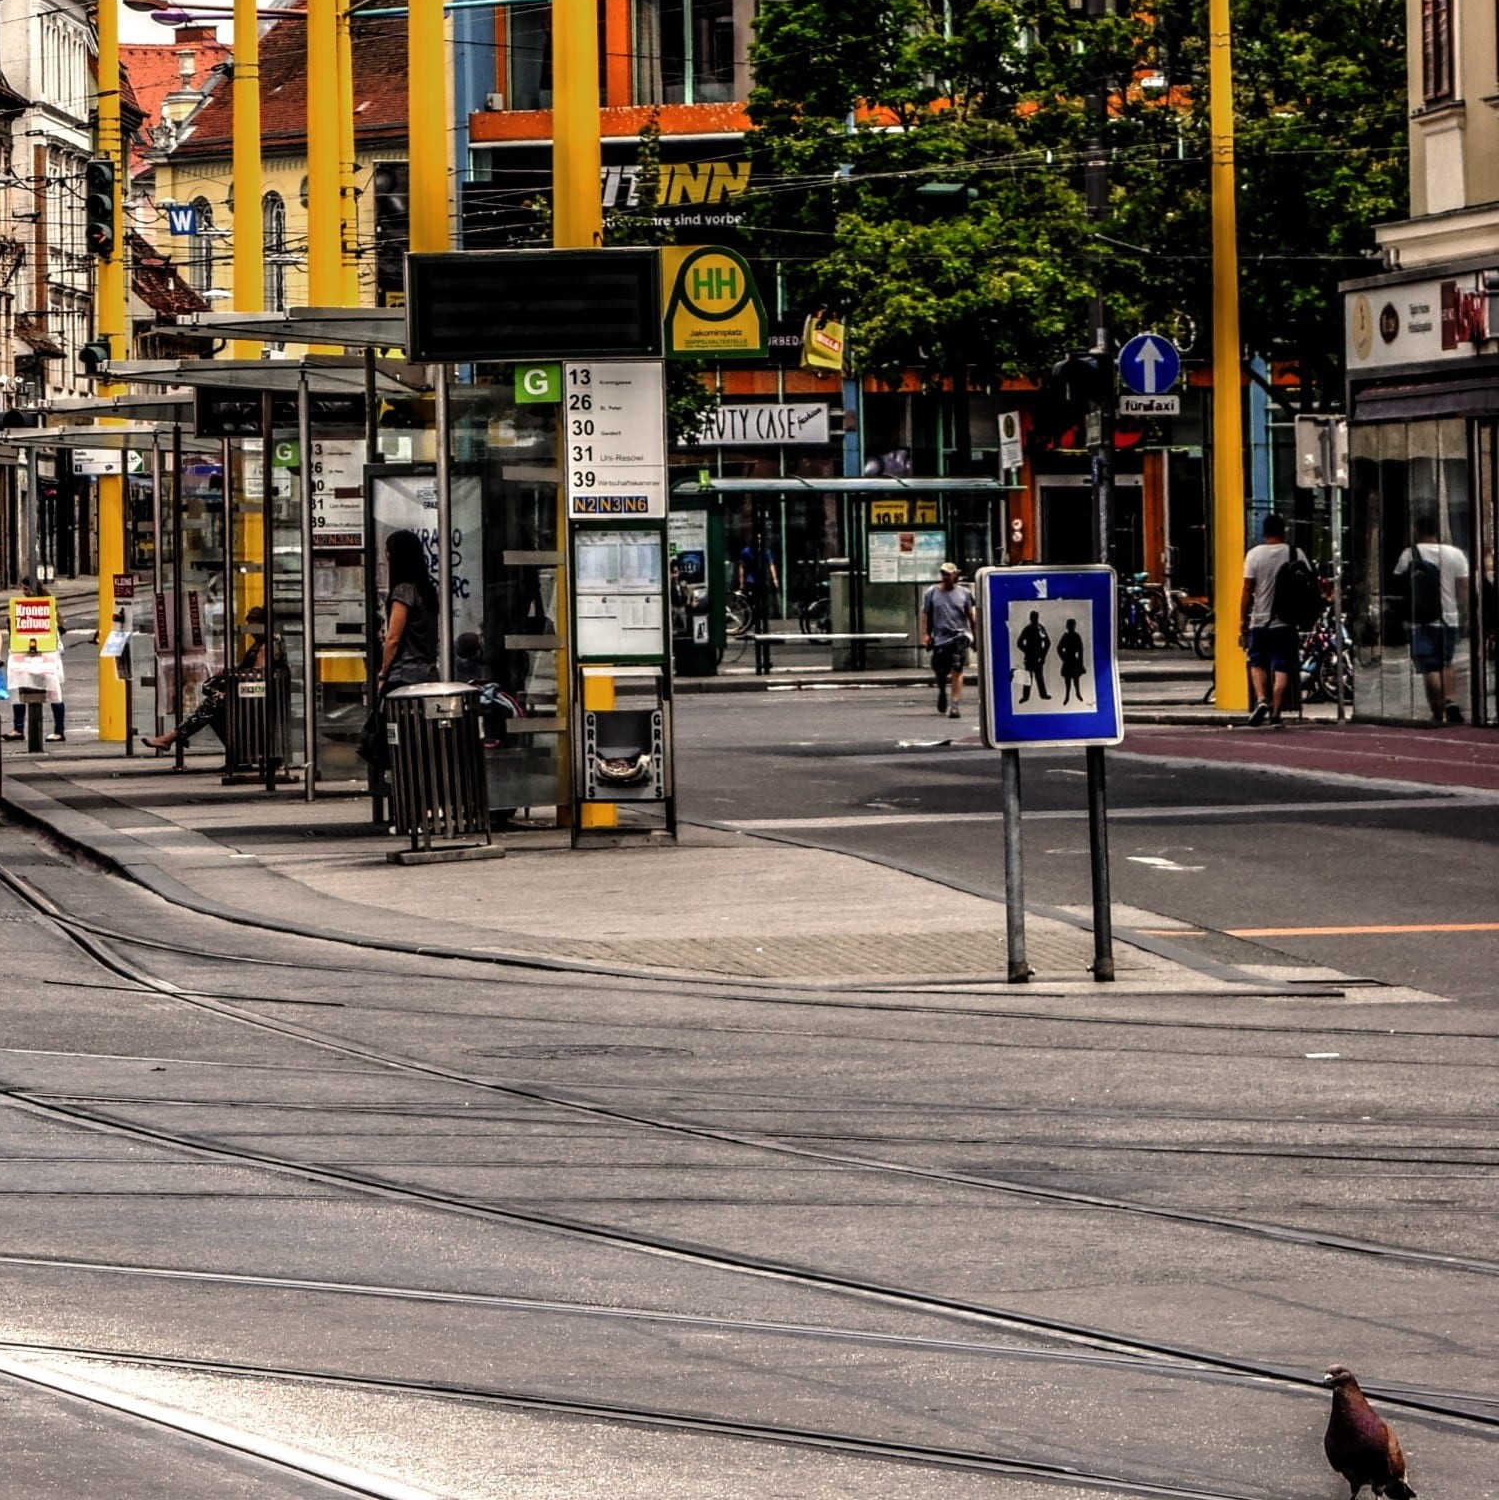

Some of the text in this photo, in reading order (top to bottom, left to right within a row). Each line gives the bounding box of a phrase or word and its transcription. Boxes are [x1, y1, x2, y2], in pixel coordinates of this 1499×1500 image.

[601, 162, 752, 207] IT INN
[172, 210, 192, 231] W
[674, 211, 701, 226] sind
[690, 329, 742, 338] Jakominiplatz
[524, 369, 549, 395] G
[569, 369, 591, 385] 13
[569, 394, 592, 411] 26
[572, 420, 594, 436] 30
[756, 408, 795, 439] CASE
[276, 442, 293, 460] G
[572, 445, 593, 462] 31
[573, 471, 596, 488] 39
[574, 497, 648, 512] N2 N3 N6
[15, 604, 50, 617] Kronen
[15, 616, 50, 631] Zeitung
[586, 714, 596, 798] GRATIS
[653, 714, 663, 798] GRATIS
